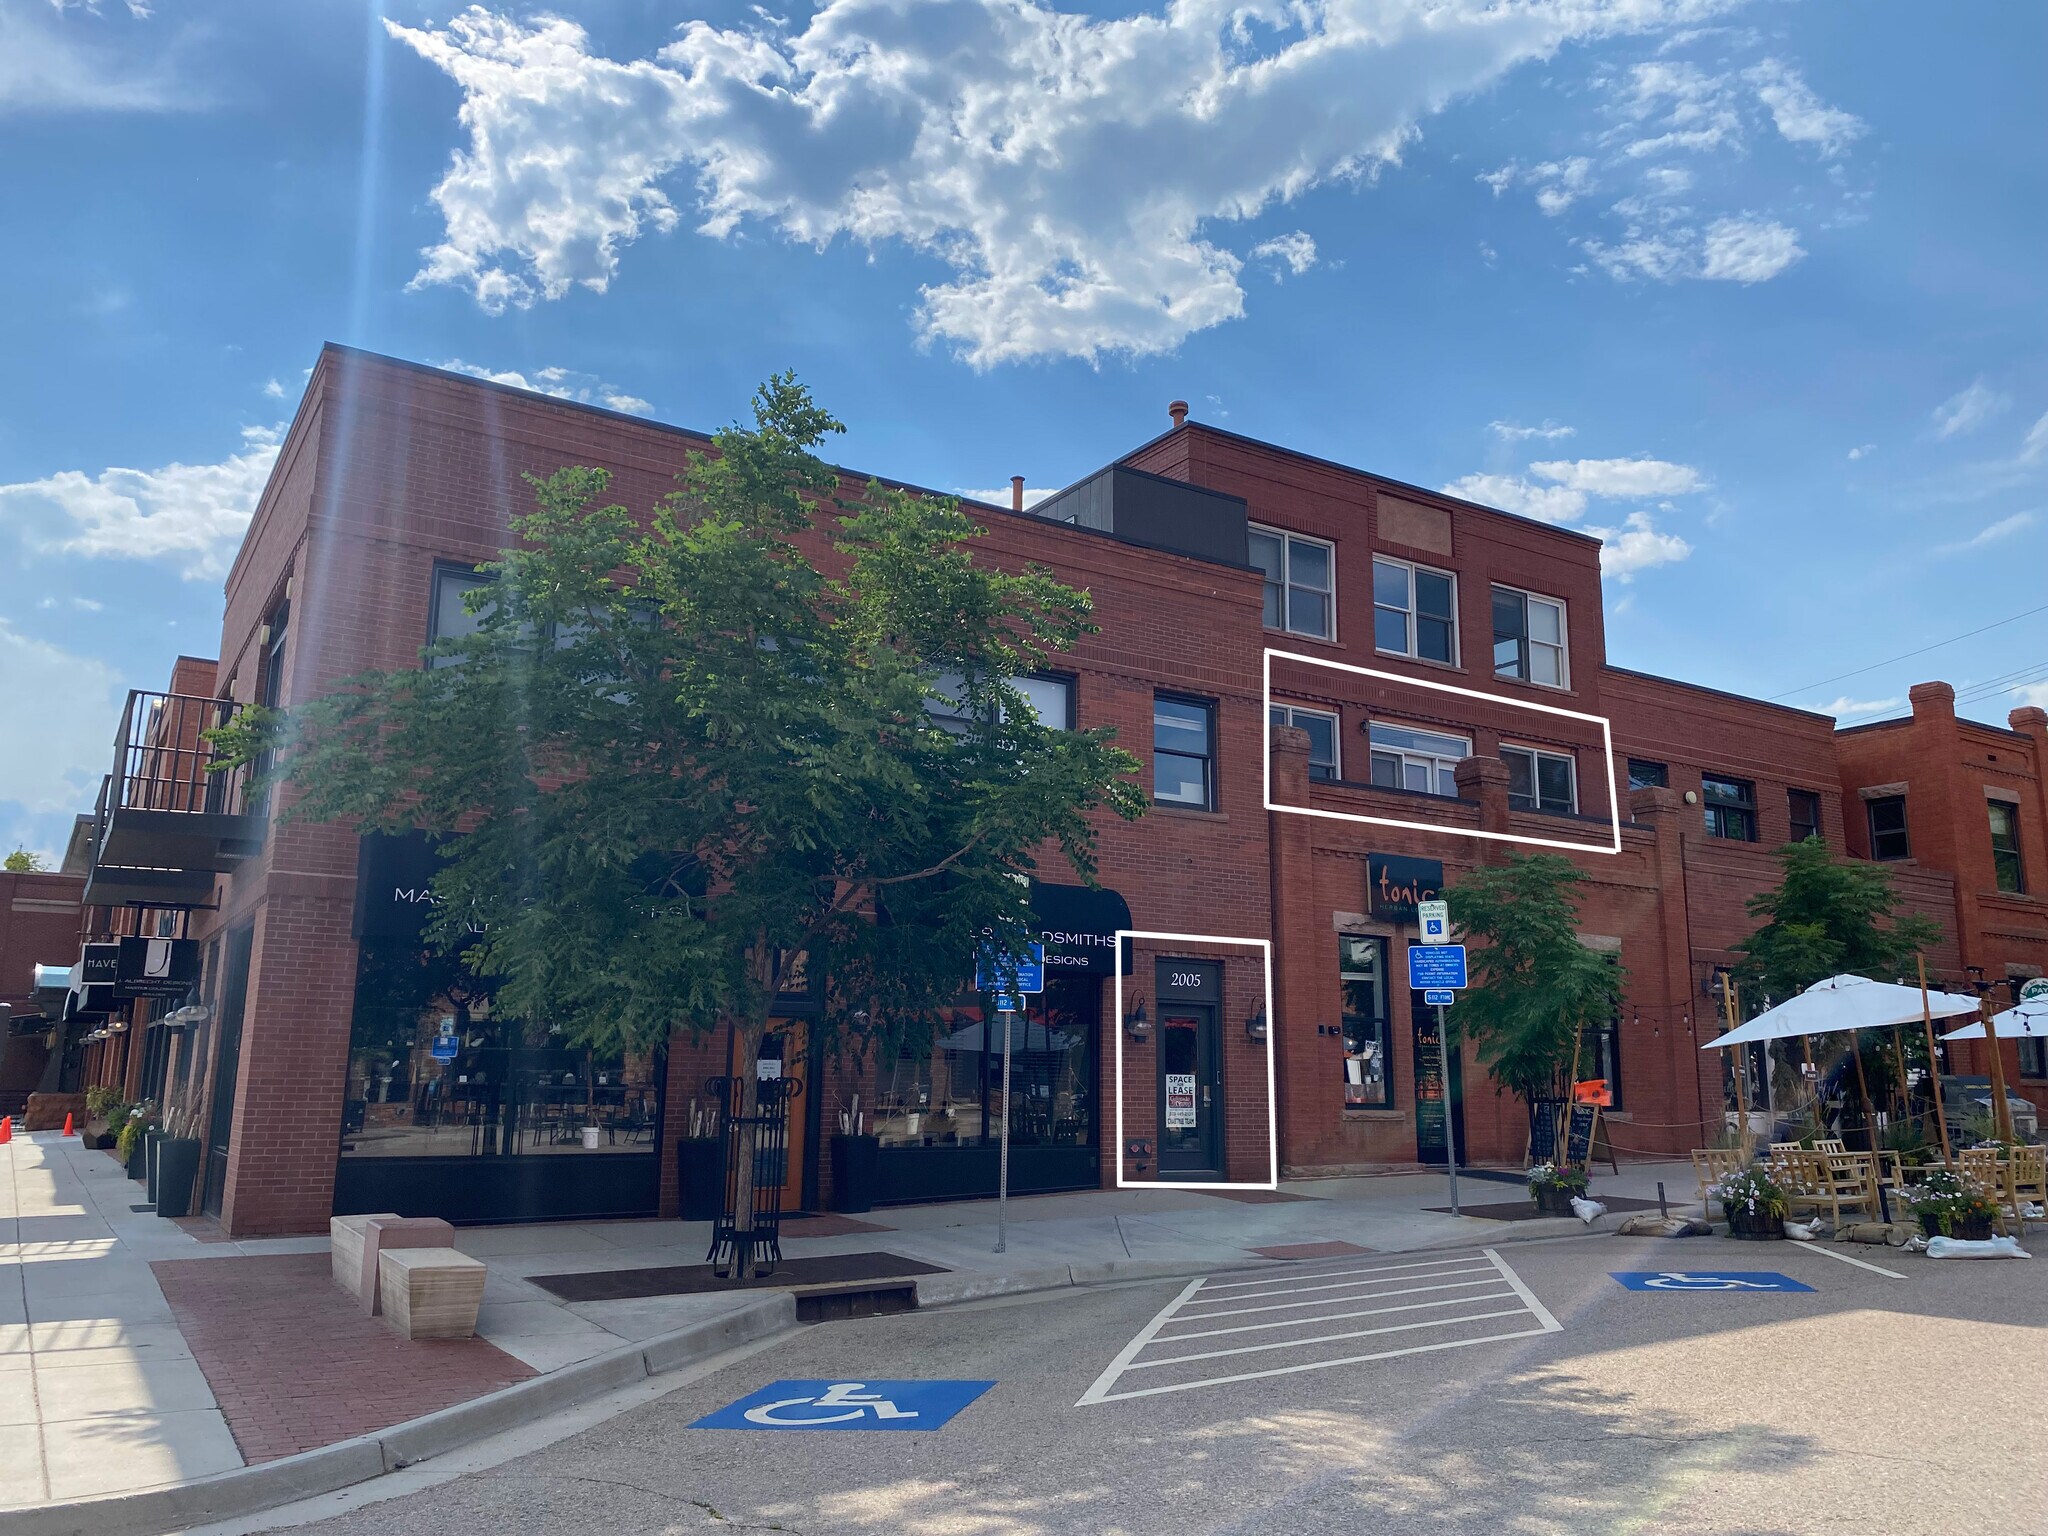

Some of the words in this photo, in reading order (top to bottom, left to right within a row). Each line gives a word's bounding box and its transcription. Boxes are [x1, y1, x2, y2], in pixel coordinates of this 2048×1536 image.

[1379, 865, 1435, 905] tonic
[1380, 904, 1408, 912] HERBAN
[1041, 931, 1116, 948] DSMITHS
[1171, 972, 1201, 987] 2005
